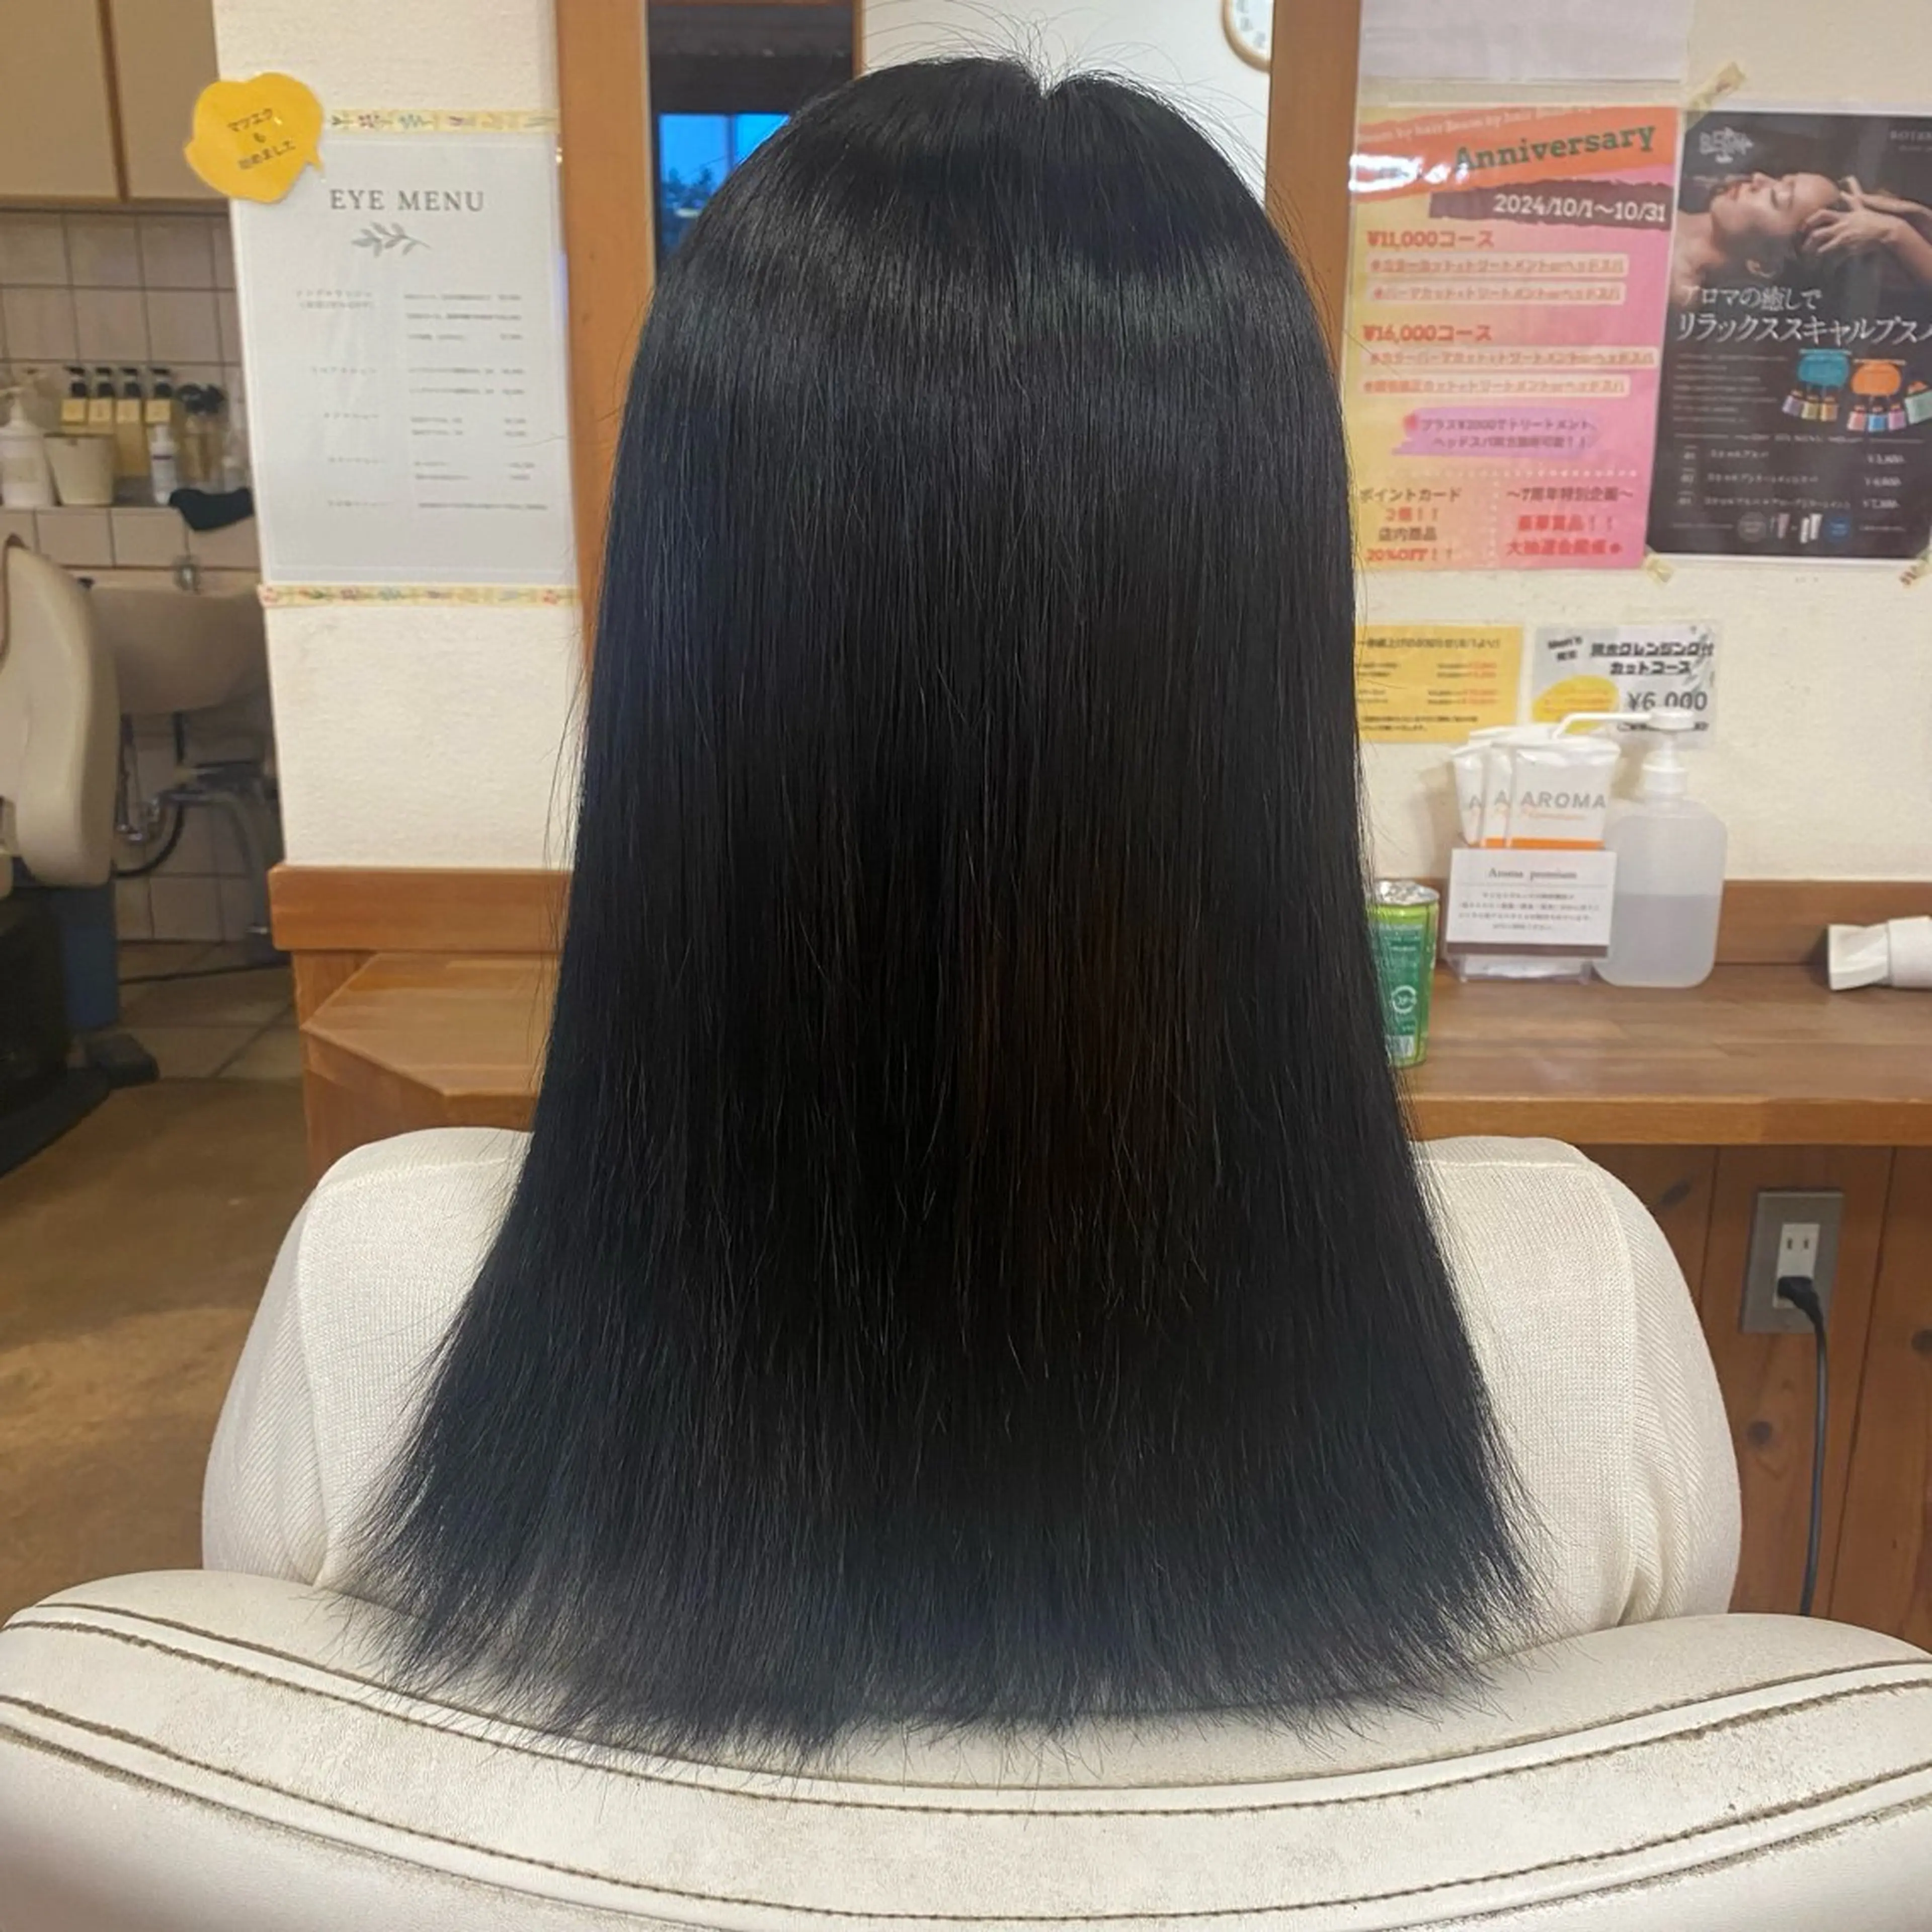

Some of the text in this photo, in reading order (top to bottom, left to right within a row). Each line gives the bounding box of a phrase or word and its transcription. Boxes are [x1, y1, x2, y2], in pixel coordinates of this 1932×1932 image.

[1455, 125, 1656, 171] Anniversary
[329, 189, 485, 212] EYE MENU
[1359, 486, 1462, 503] ポイントカード
[1609, 660, 1691, 676] カットコース
[1520, 790, 1606, 809] AROMA
